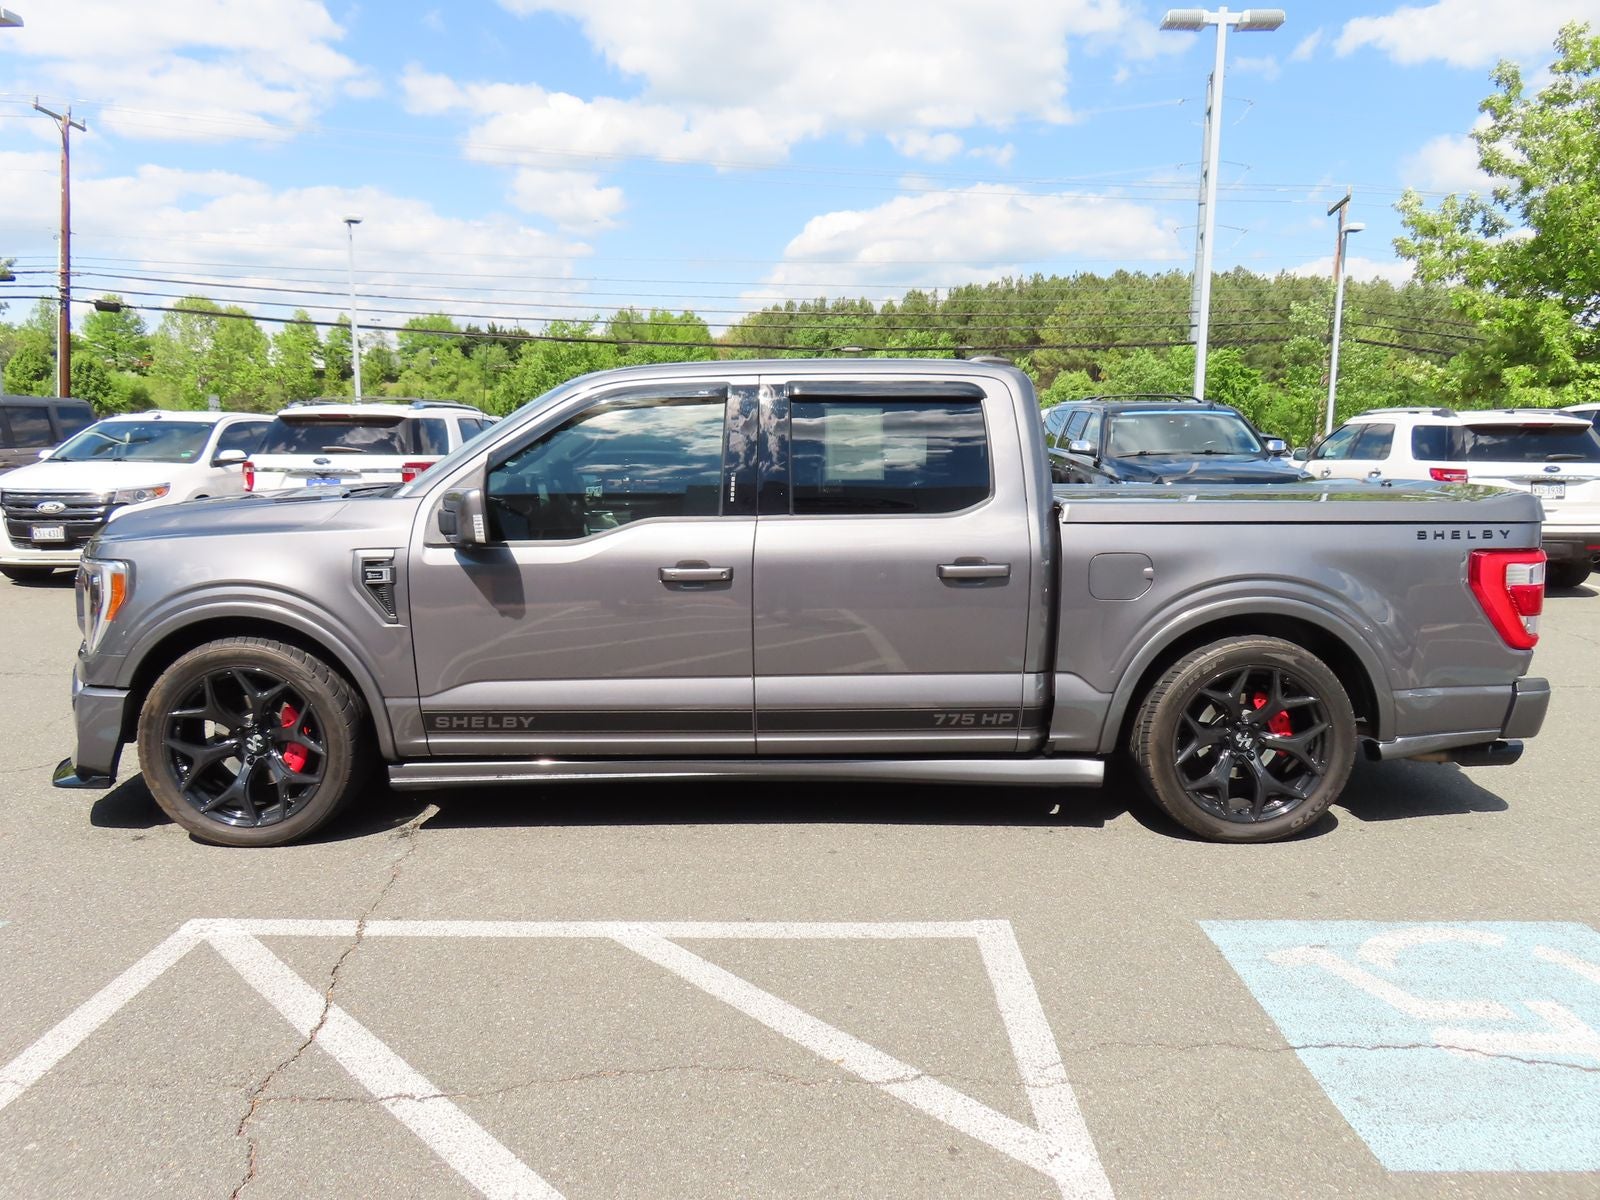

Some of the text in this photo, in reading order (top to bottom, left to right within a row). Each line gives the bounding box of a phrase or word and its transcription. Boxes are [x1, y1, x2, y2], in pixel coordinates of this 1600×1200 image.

[1416, 529, 1511, 540] SHELBY
[434, 715, 536, 729] SHELBY
[933, 712, 1014, 726] 775 HP
